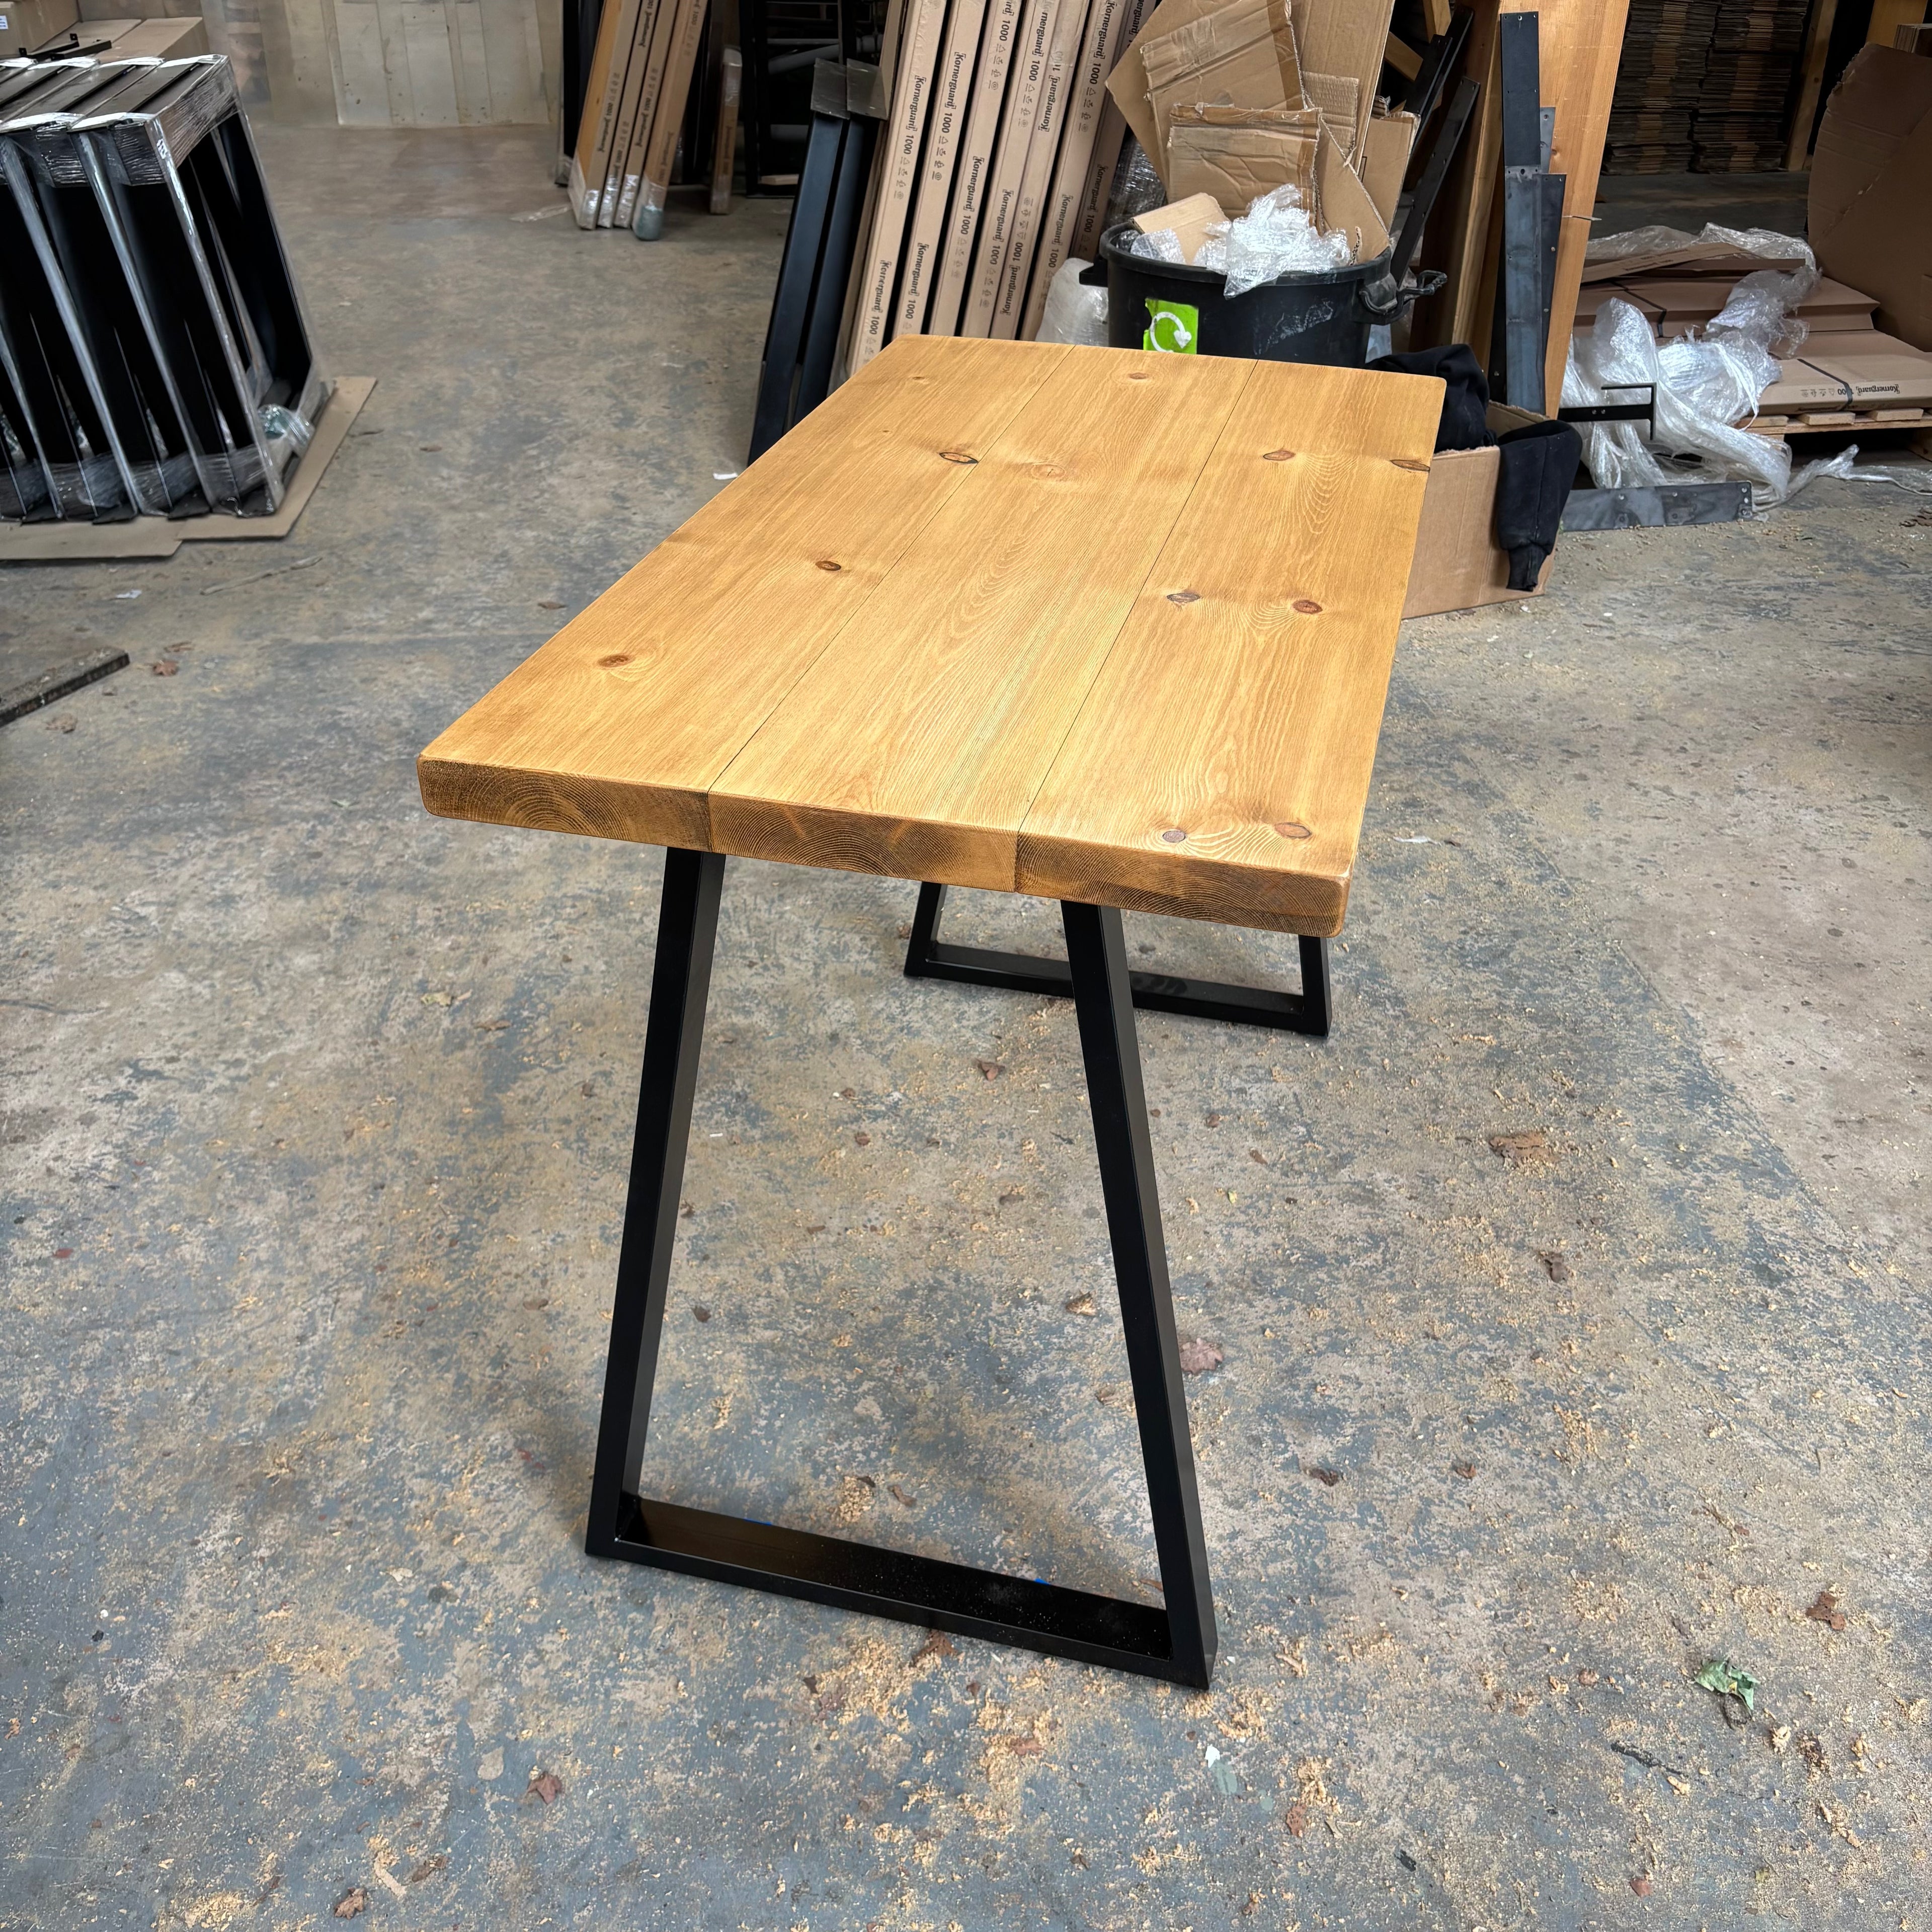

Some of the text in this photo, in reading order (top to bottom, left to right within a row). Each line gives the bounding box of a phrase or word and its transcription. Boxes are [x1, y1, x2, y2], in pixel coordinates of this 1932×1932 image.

[1129, 0, 1145, 35] erguard
[1000, 20, 1010, 41] 1000
[1029, 2, 1051, 81] rnerguard 1000
[1090, 63, 1101, 85] 1000
[942, 52, 966, 133] Kornerguard 1000
[1038, 75, 1060, 132] Kornerguard
[904, 135, 914, 154] 1000
[960, 156, 984, 235] Kornerguard 1000
[1084, 215, 1094, 232] 1000
[990, 246, 1000, 265] 1000
[1013, 242, 1023, 261] 1000
[1049, 249, 1059, 268] 1000
[906, 300, 916, 319] 1000
[869, 316, 879, 335] 1000
